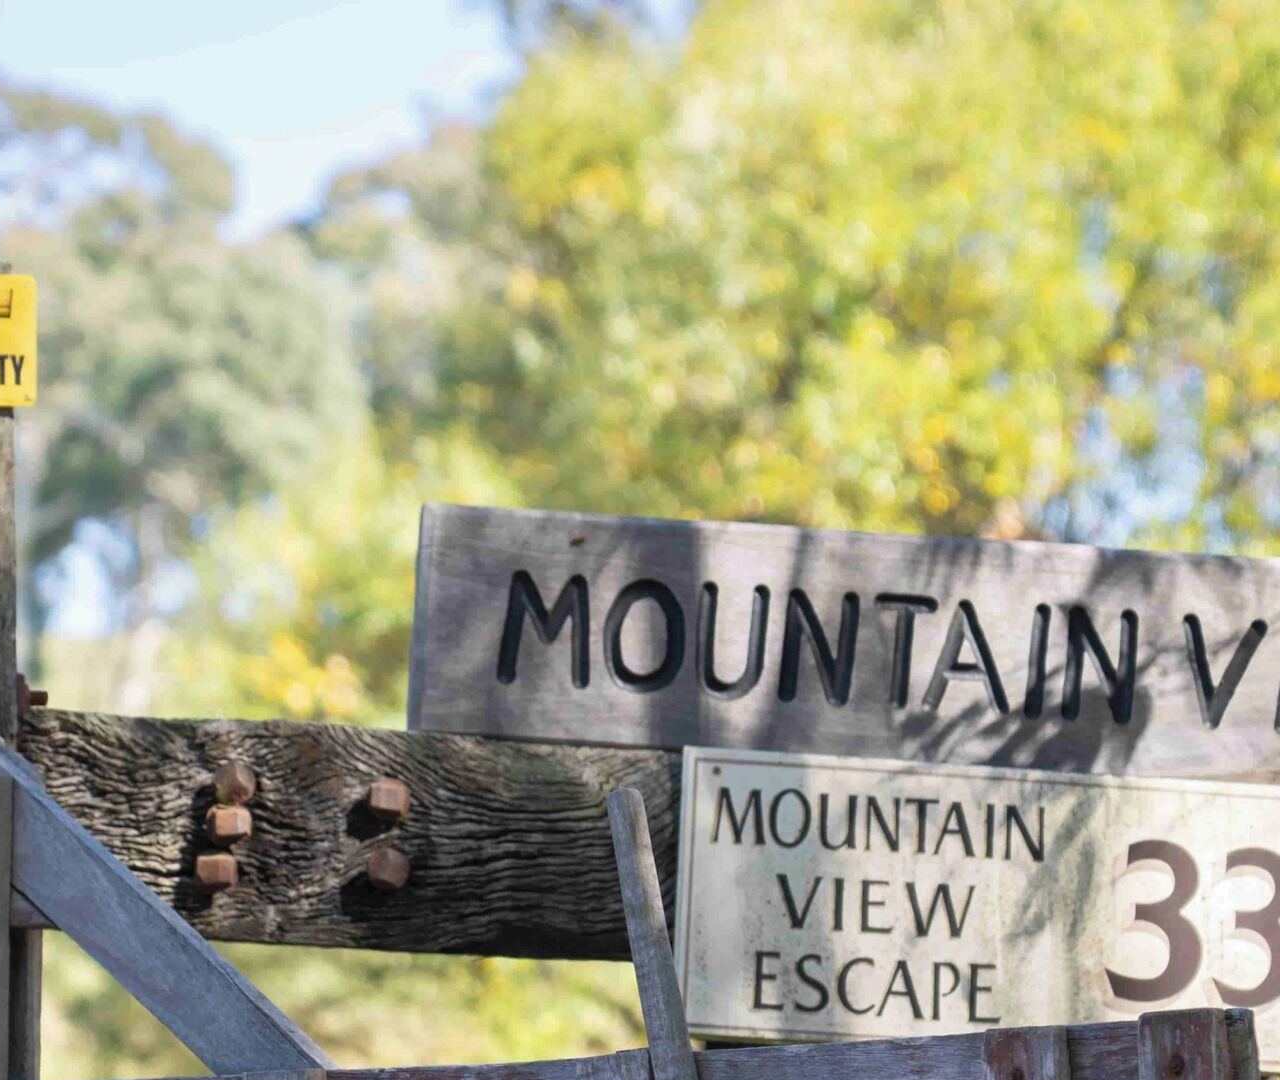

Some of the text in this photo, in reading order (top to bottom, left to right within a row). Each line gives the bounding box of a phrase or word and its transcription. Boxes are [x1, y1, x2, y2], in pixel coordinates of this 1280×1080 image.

[496, 570, 1138, 726] MOUNTAIN
[712, 786, 1046, 862] MOUNTAIN
[776, 872, 976, 940] VIEW
[753, 950, 1001, 1024] ESCAPE
